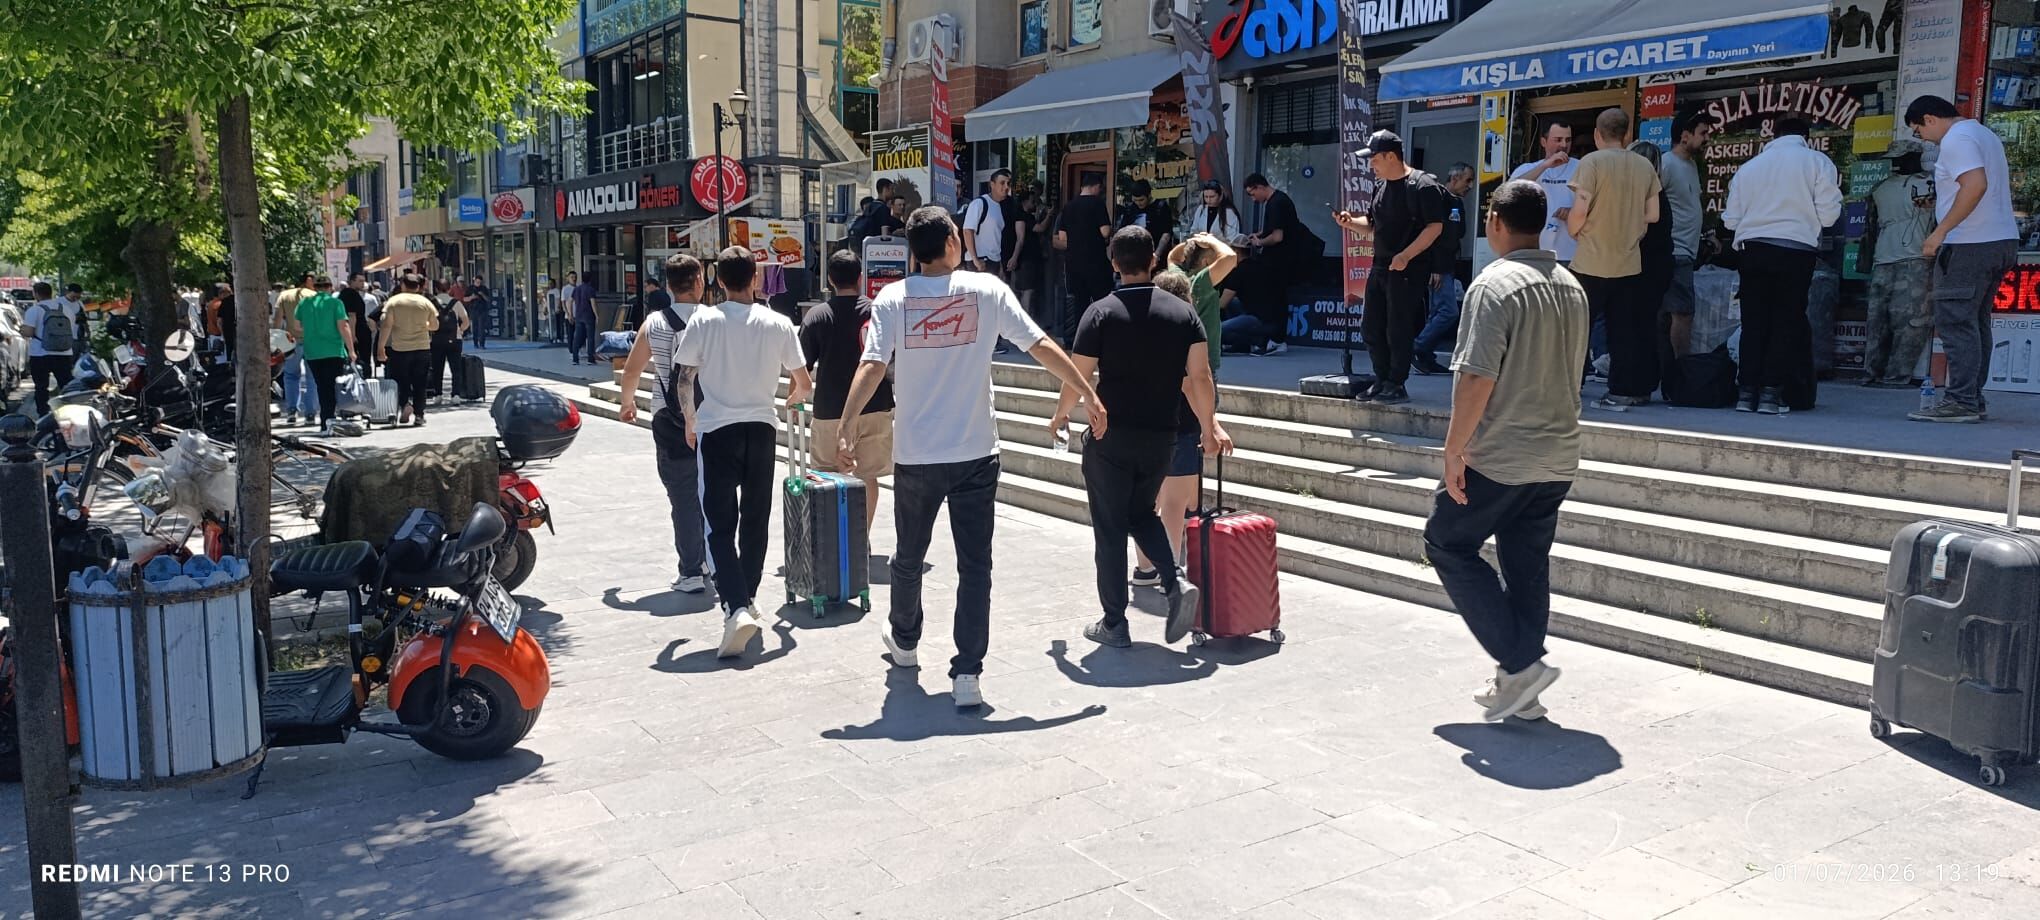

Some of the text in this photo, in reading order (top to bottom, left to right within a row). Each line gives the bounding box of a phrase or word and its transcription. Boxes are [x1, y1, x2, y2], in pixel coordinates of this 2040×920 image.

[1460, 59, 1545, 88] KIŞLA
[1706, 46, 1749, 60] Dayının
[1752, 41, 1775, 54] Yeri
[1644, 93, 1671, 109] ŞARJ
[1704, 139, 1753, 160] ASKERİ
[567, 181, 637, 217] ANADOLU
[1314, 301, 1334, 313] OTO
[478, 597, 492, 618] 24
